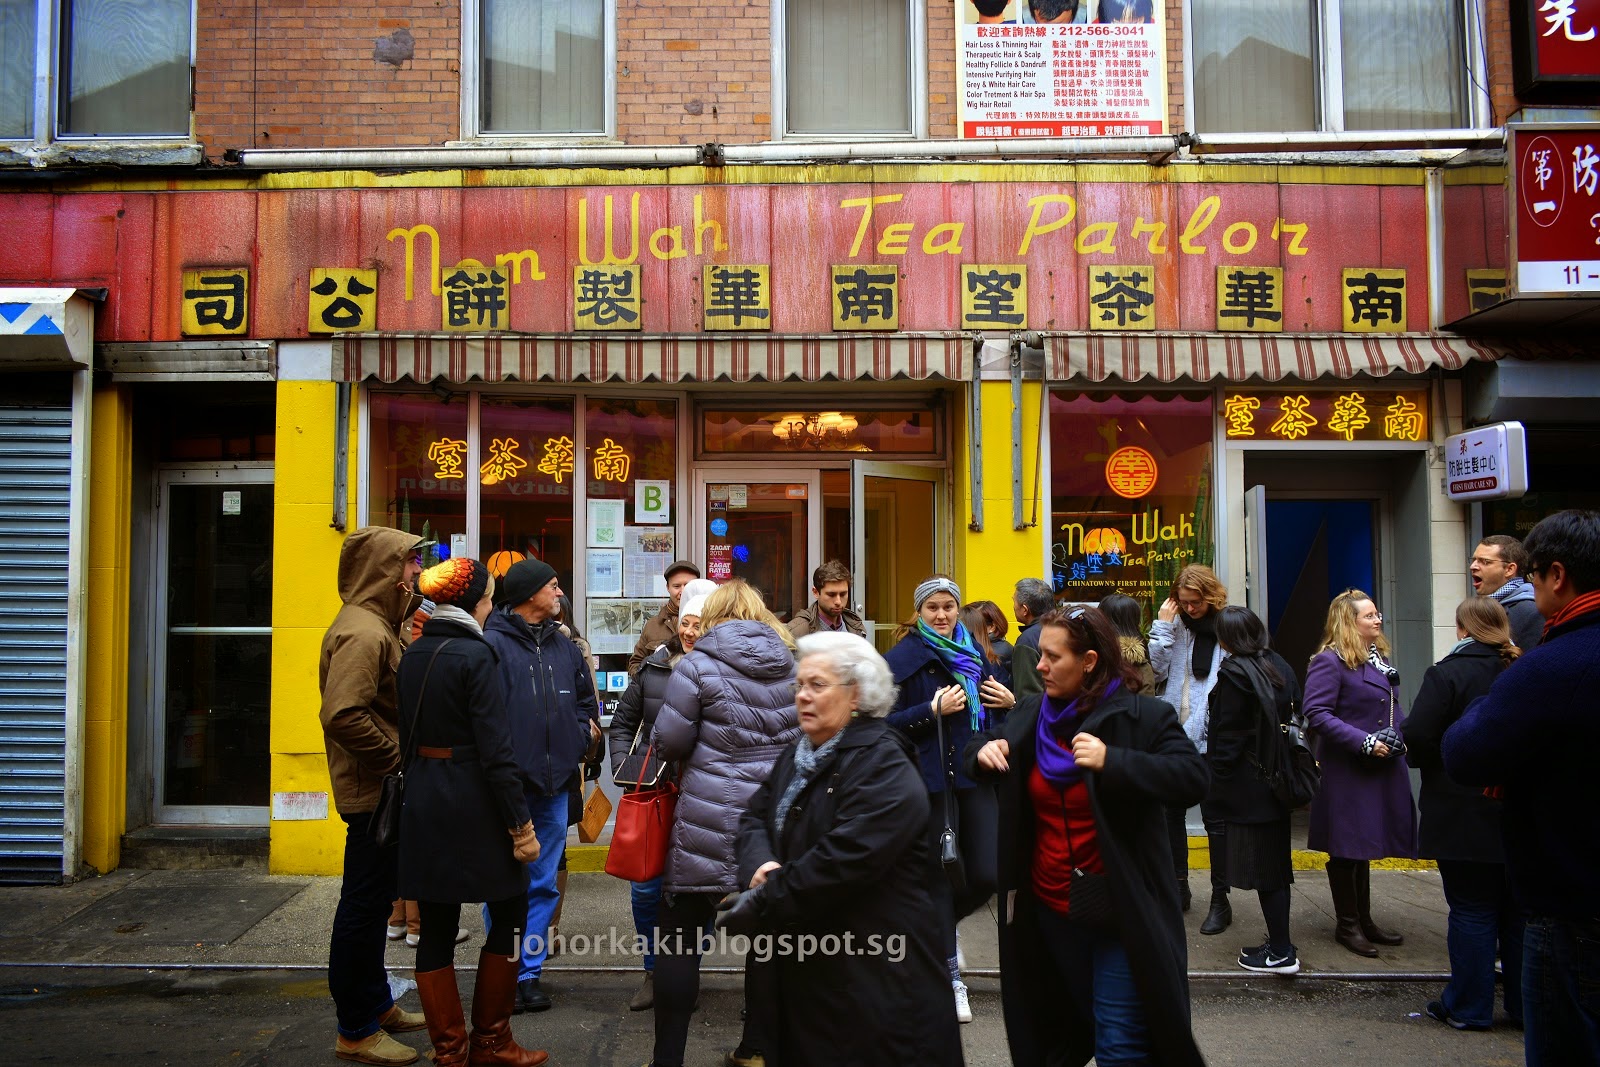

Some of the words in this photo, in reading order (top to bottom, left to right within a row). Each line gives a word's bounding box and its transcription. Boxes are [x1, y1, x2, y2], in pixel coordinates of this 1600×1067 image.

[1059, 26, 1144, 36] 212-566-3041
[1002, 41, 1028, 49] Thinning
[966, 51, 1001, 59] Therapeutic
[1024, 51, 1041, 59] Scalp
[965, 61, 989, 69] Healthy
[995, 71, 1022, 79] Purifying
[966, 81, 980, 89] Grey
[1034, 91, 1046, 99] Spa
[966, 101, 978, 109] Wig
[578, 191, 728, 266] Wah
[840, 193, 966, 258] Tea
[1017, 194, 1310, 256] Parlor
[1474, 480, 1486, 489] CARE
[1485, 479, 1495, 488] SPA
[644, 485, 662, 512] B
[1131, 509, 1195, 545] Wah
[1120, 553, 1143, 567] Tea
[1147, 547, 1195, 566] Parlor
